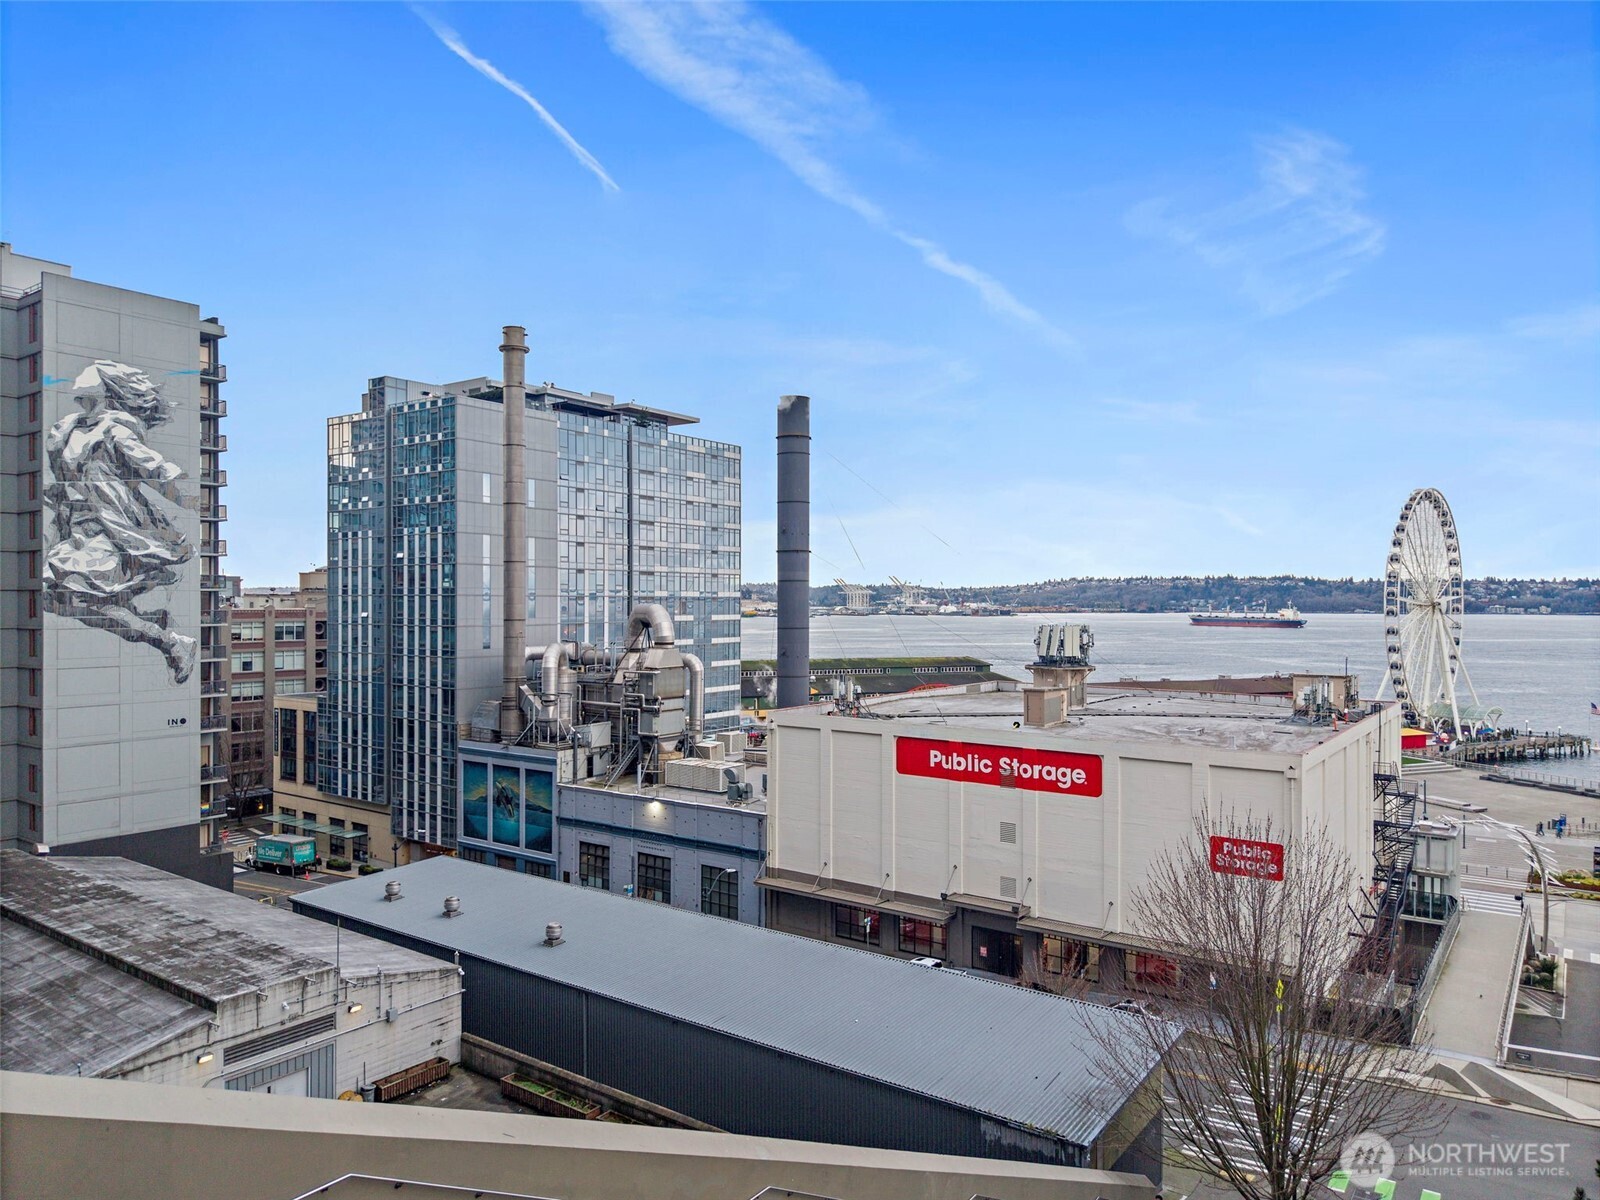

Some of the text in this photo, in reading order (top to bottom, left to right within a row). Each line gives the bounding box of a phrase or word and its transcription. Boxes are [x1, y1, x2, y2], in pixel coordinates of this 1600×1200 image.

[929, 749, 1088, 789] Public Storage
[1222, 841, 1272, 860] Public
[1215, 853, 1278, 876] Storage
